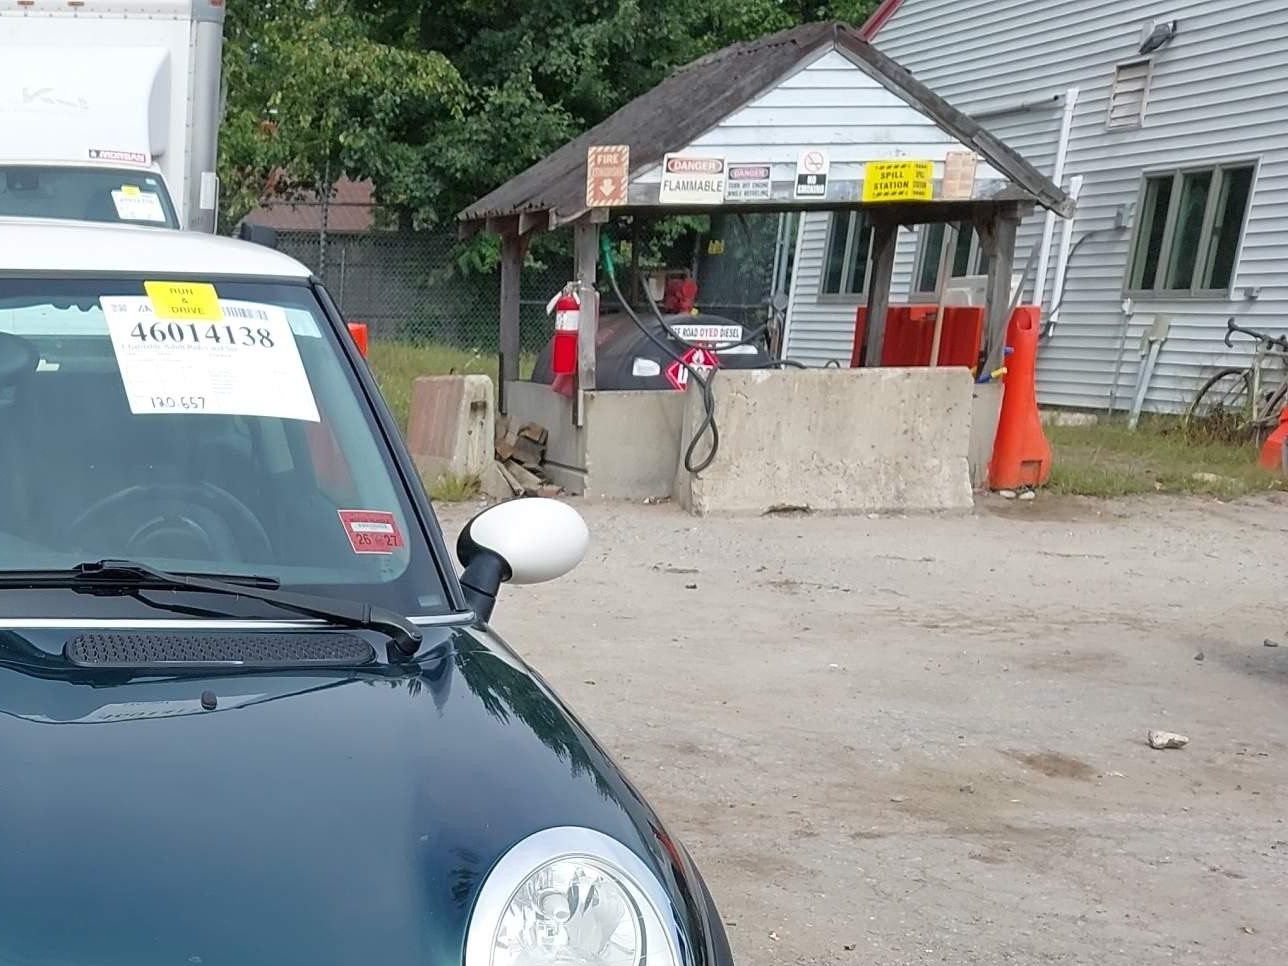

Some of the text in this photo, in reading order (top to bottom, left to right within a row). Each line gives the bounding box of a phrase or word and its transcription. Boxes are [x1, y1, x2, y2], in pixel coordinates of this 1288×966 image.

[596, 153, 619, 165] FIRE
[673, 159, 716, 170] DANGER
[880, 171, 904, 179] SPILL
[663, 180, 723, 192] FLAMMABLE
[874, 181, 909, 190] STATION
[169, 287, 194, 295] RUN
[171, 306, 205, 315] DRIVE
[130, 321, 275, 349] 46014138
[682, 327, 699, 337] ROAD
[699, 327, 719, 338] DYED
[719, 327, 740, 338] DIESEL
